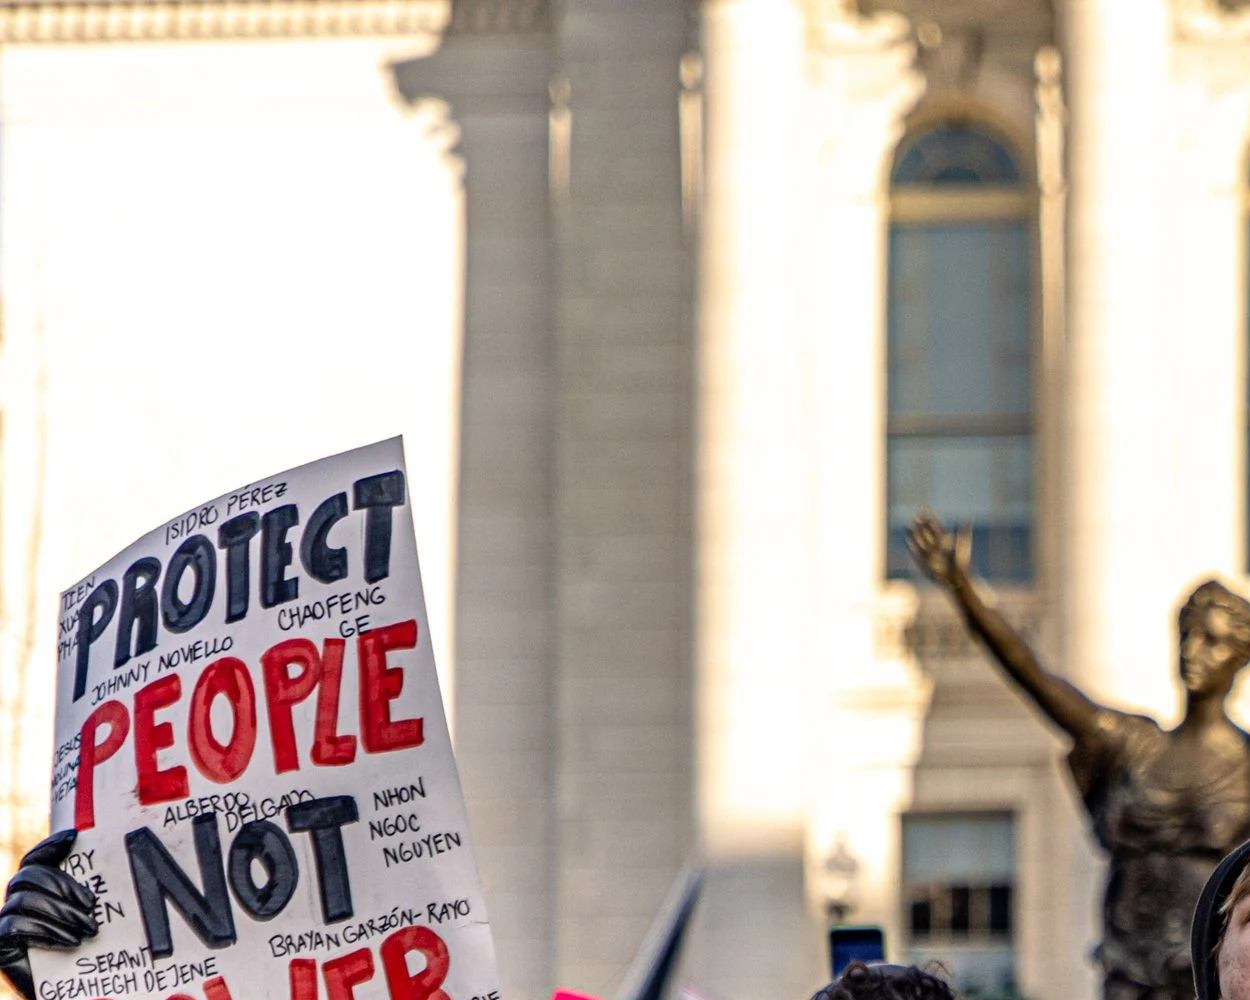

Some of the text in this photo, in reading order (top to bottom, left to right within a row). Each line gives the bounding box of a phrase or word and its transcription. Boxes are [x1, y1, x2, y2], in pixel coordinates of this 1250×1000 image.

[165, 482, 288, 546] ISIDRO PÉREZ
[72, 469, 406, 703] PROTECT
[277, 586, 386, 632] CHAOFENG
[339, 615, 371, 639] GE
[91, 635, 233, 706] JOHNNY NOVIELLO
[74, 619, 425, 832] PEOPLE
[373, 776, 426, 811] NHON
[368, 813, 420, 840] NGOC
[382, 832, 461, 868] NGUYEN
[124, 794, 359, 960] NOT
[268, 930, 340, 958] BRAYAN
